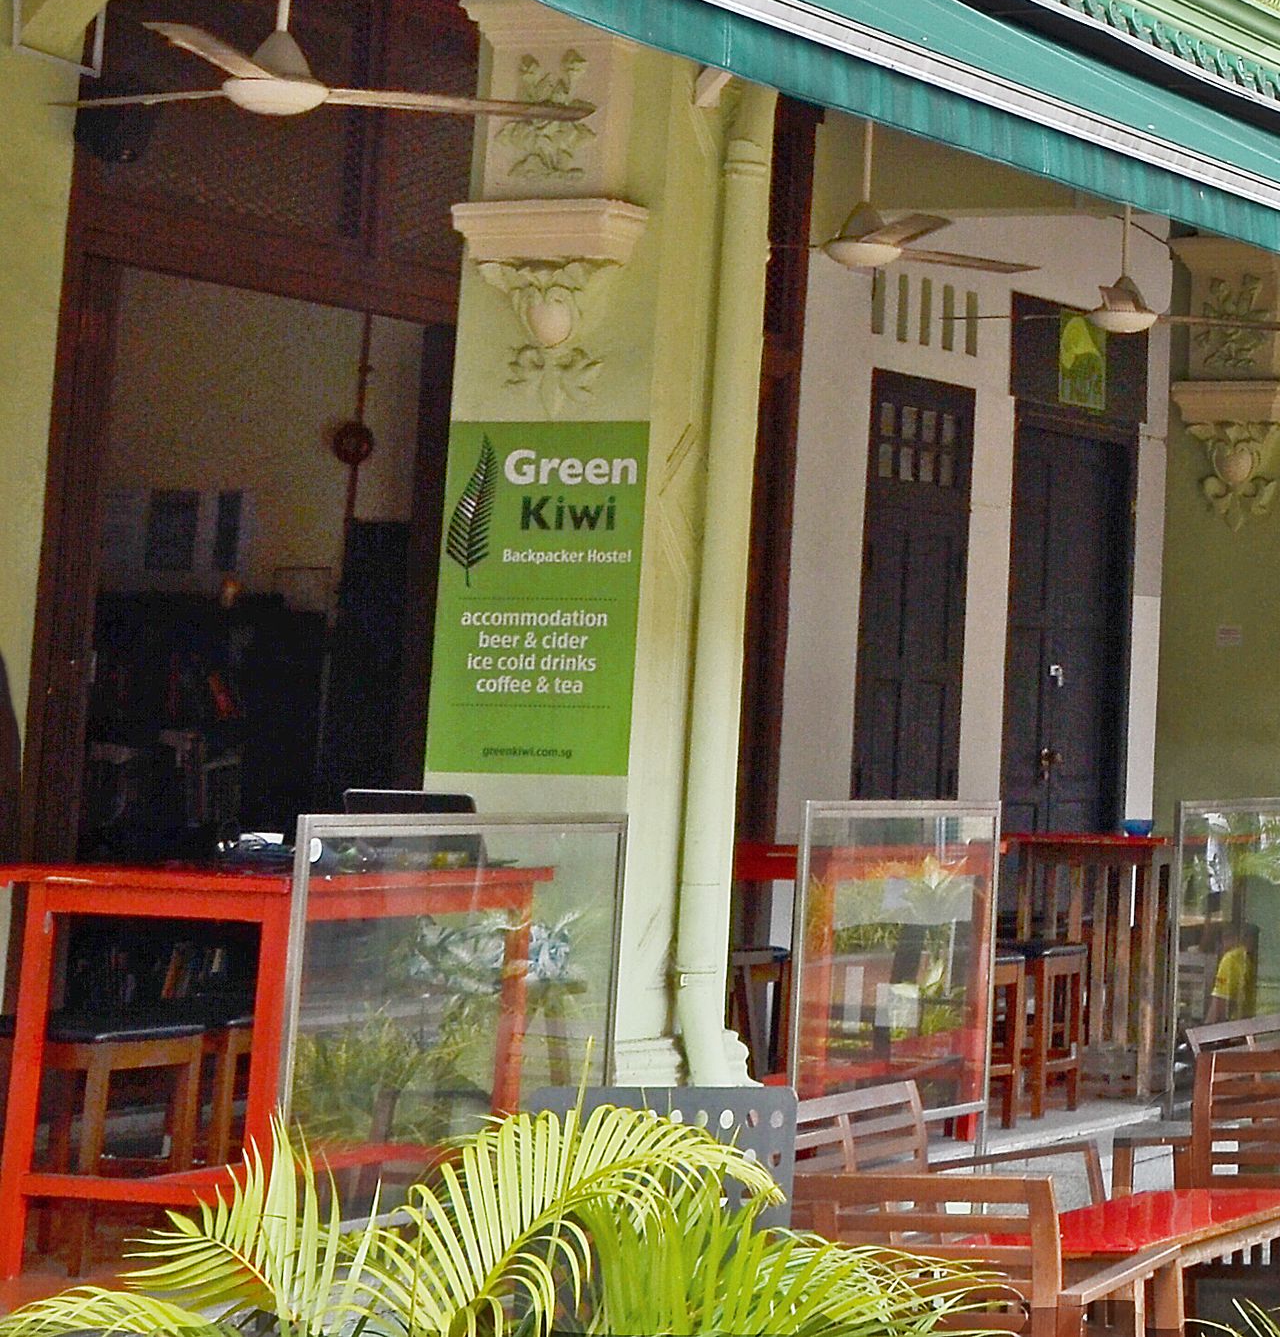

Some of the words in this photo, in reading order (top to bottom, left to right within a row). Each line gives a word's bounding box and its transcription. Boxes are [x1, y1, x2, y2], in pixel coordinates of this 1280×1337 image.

[504, 448, 638, 485] Green
[520, 494, 616, 531] Kiwi
[503, 548, 584, 564] Backpacker
[587, 549, 633, 563] Hostel
[460, 610, 609, 627] accommodation
[478, 631, 521, 649] beer
[524, 631, 537, 649] &
[542, 632, 589, 649] cider
[467, 653, 493, 670] ice
[497, 654, 535, 671] cold
[540, 654, 597, 671] drinks
[476, 675, 532, 693] coffee
[536, 675, 549, 694] &
[554, 677, 584, 694] tea
[482, 746, 573, 759] greenkiwi.com.sg
